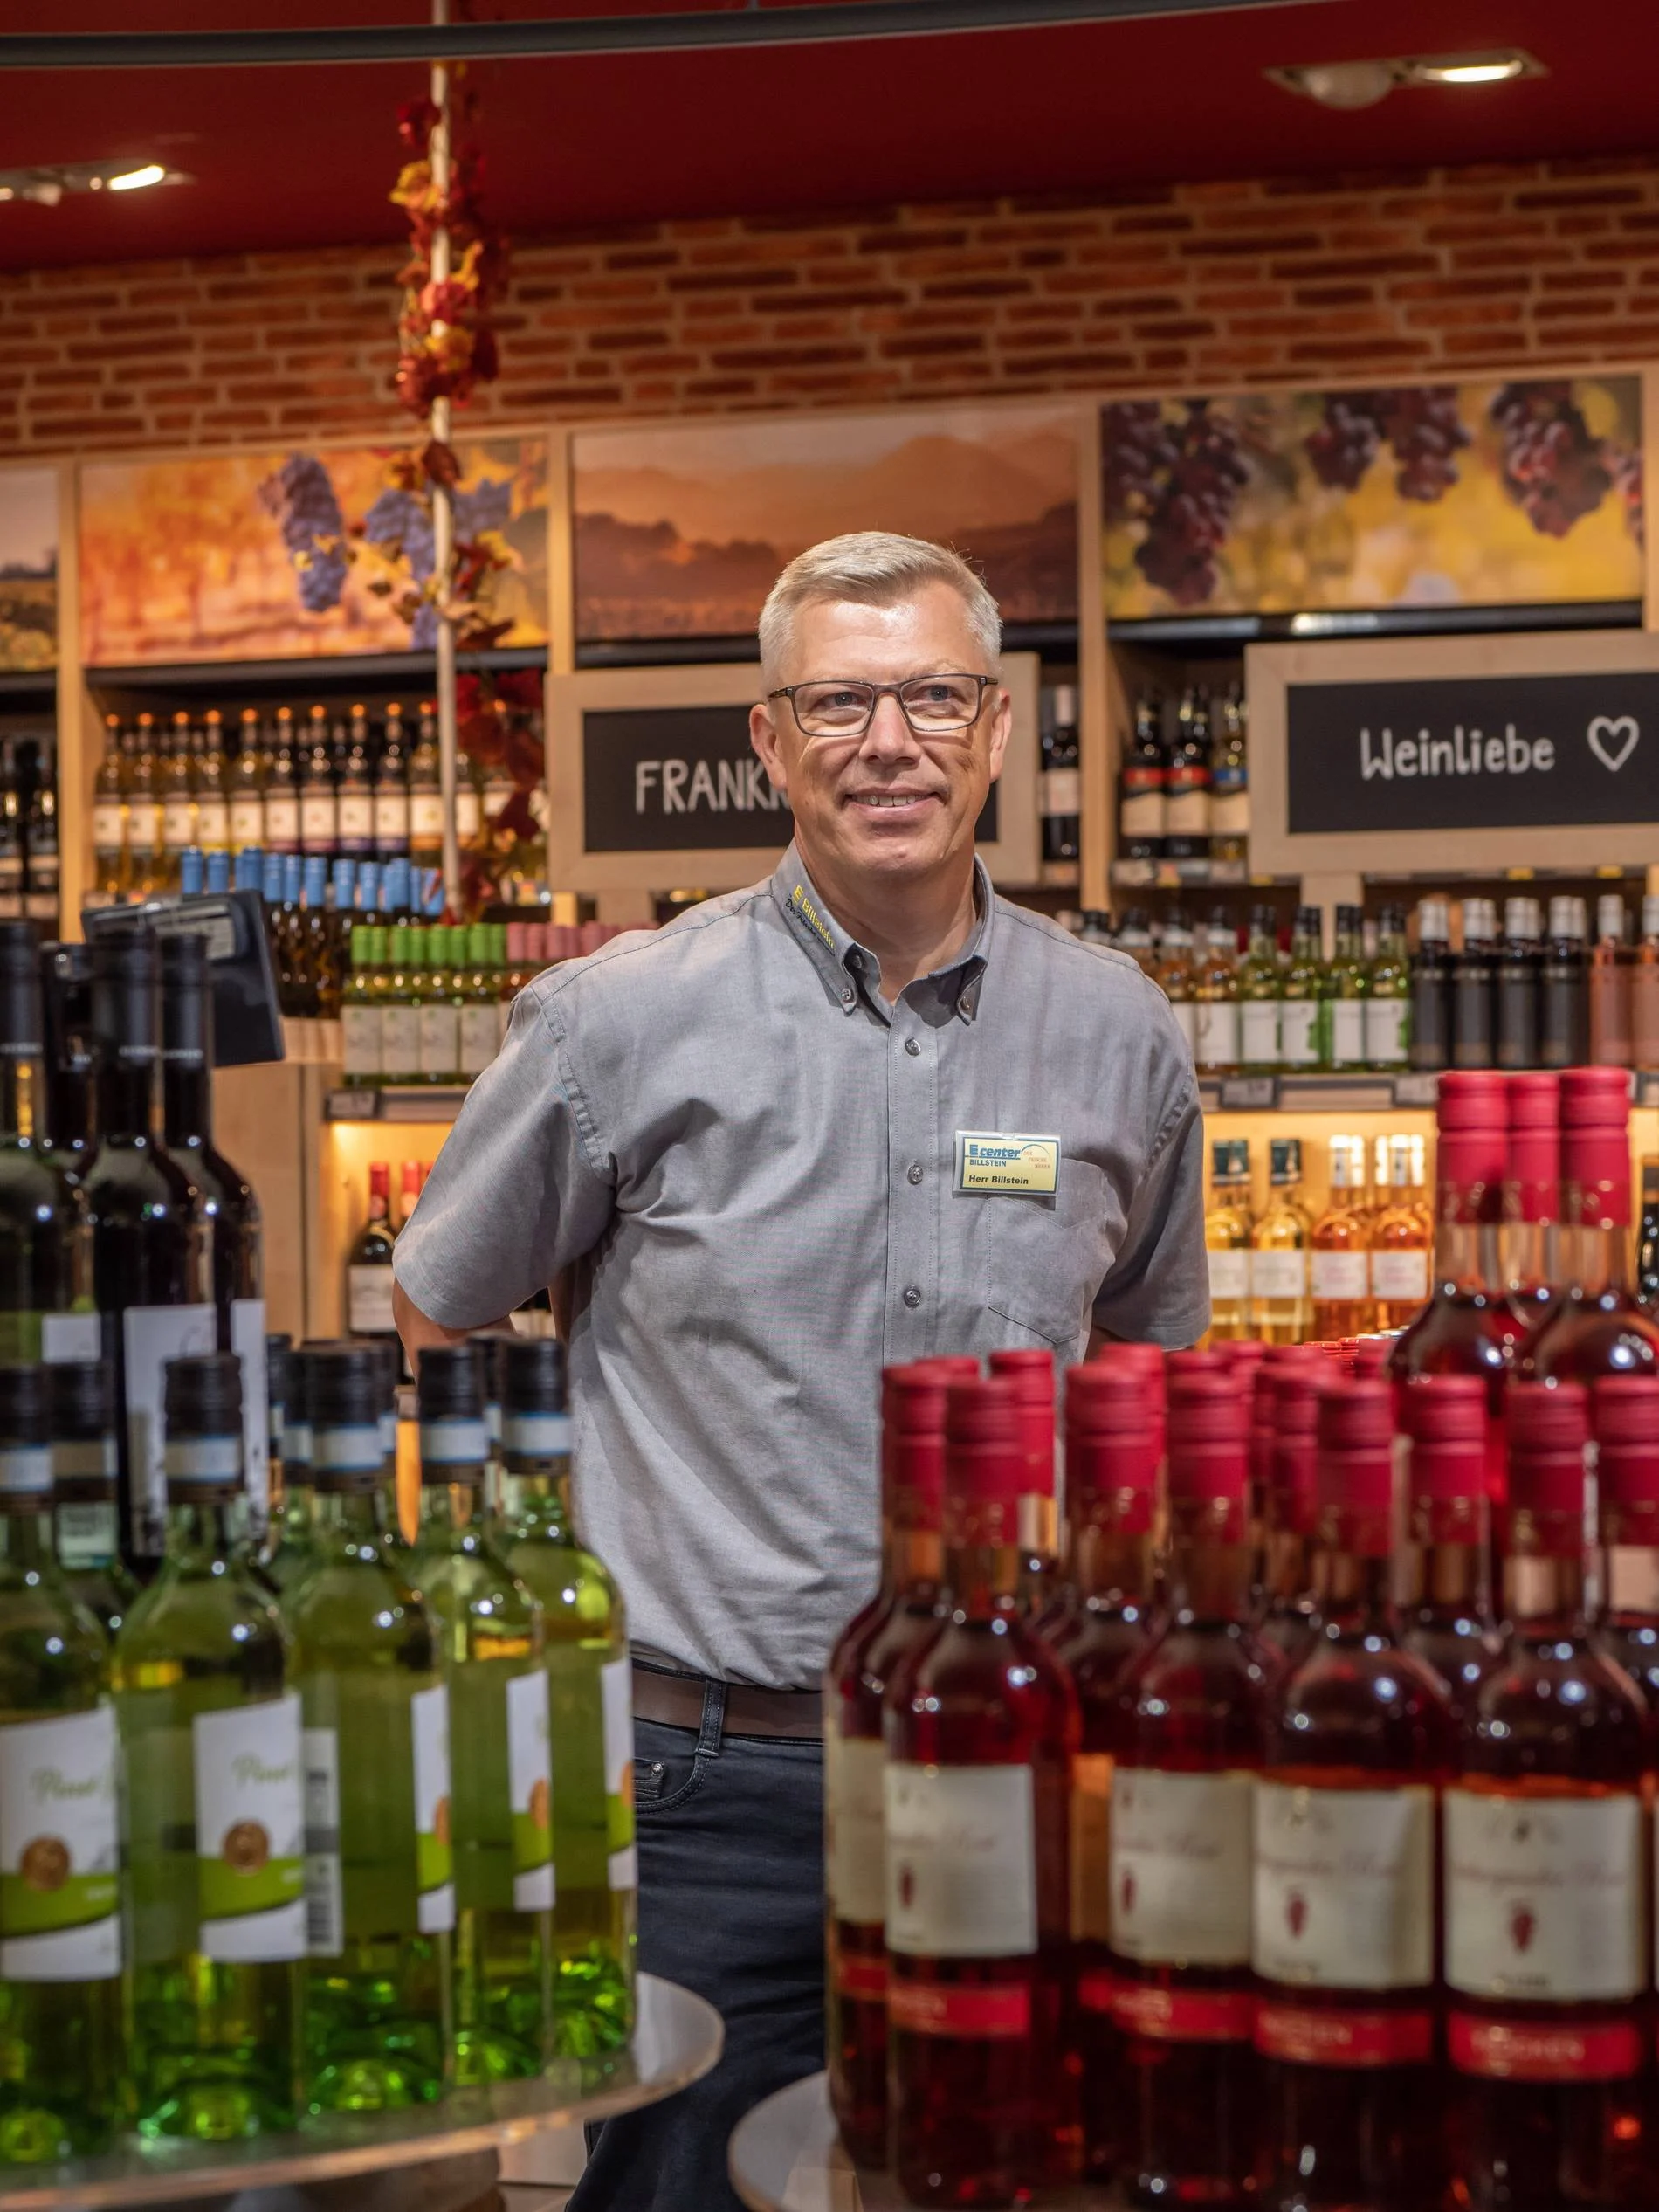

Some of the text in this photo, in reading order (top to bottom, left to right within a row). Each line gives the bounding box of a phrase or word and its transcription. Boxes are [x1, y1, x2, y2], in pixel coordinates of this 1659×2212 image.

[1360, 723, 1555, 780] Weinliebe
[968, 1175, 1029, 1185] Herr Billstein
